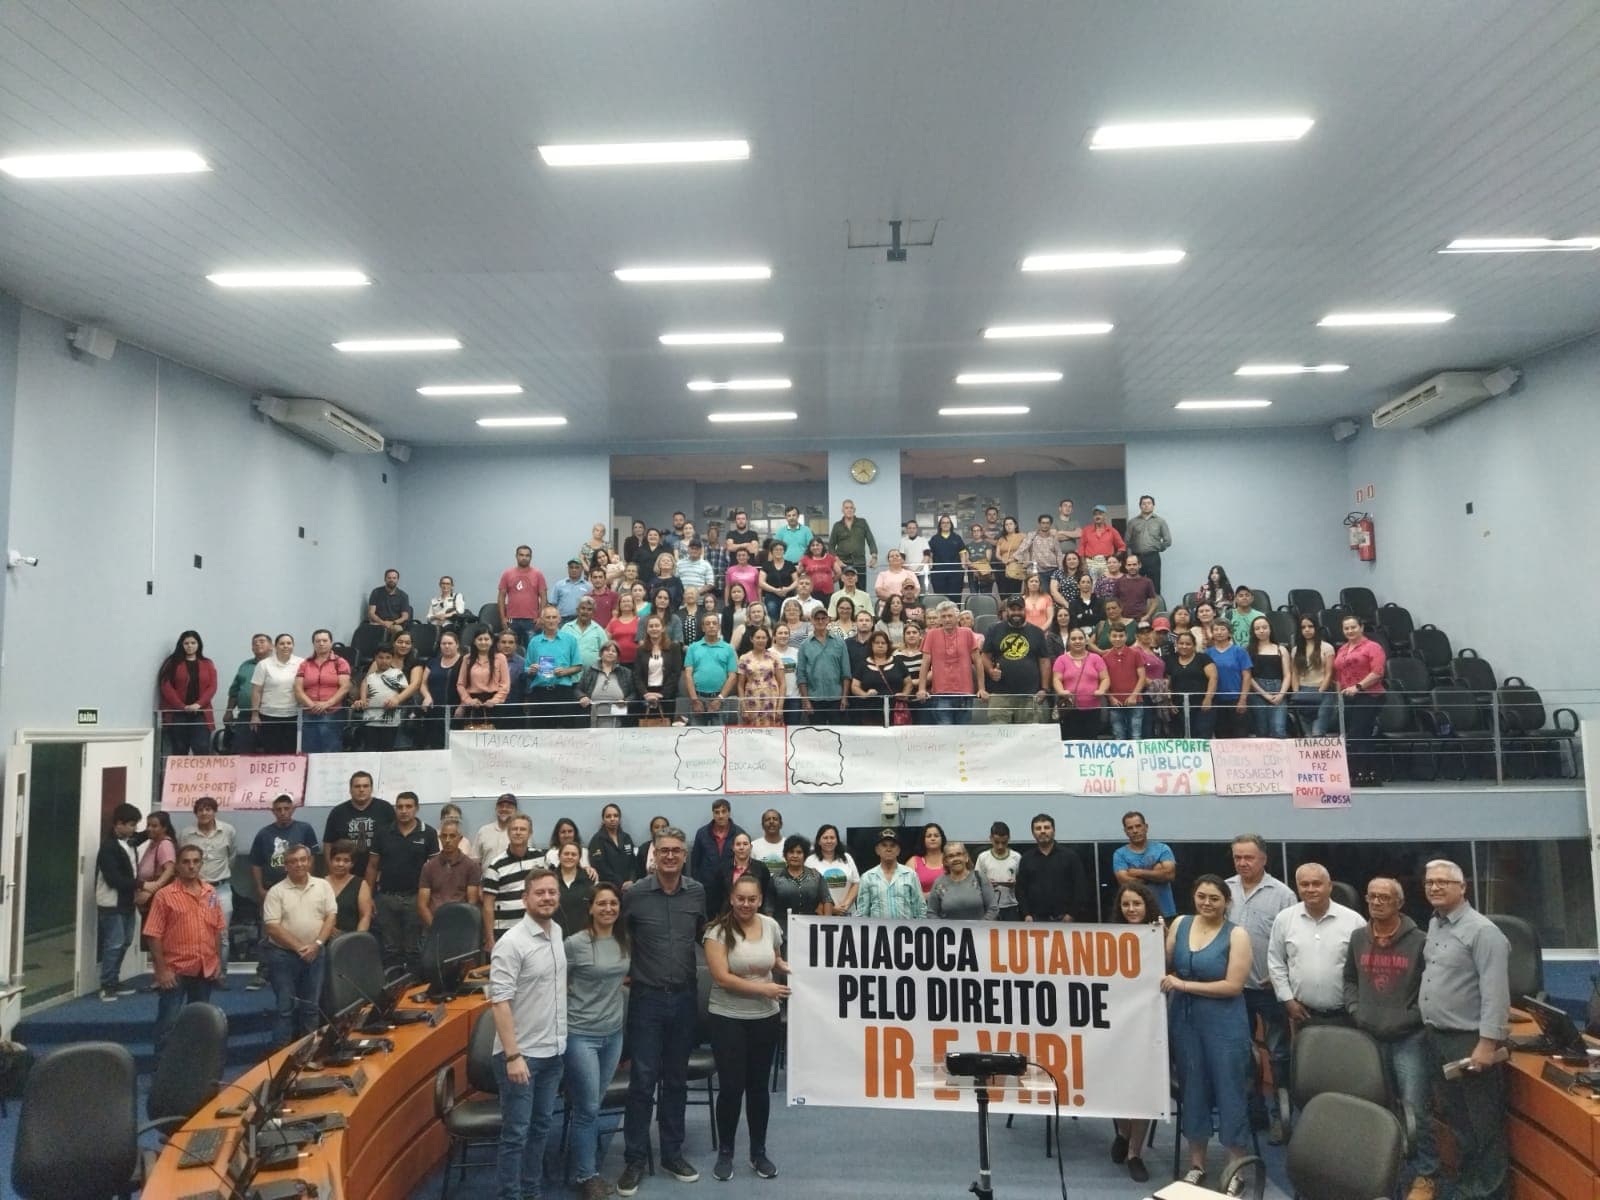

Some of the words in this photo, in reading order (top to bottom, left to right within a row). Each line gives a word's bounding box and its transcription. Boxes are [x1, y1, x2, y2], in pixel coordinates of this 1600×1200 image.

[79, 711, 96, 721] SAÍDA
[474, 732, 538, 748] ITAIACOCA
[1295, 737, 1342, 747] ITAIACOCA
[1064, 742, 1134, 759] ITAIACOCA
[1137, 740, 1210, 754] TRANSPORTE
[1298, 748, 1341, 759] TAMBÉM
[170, 757, 236, 770] PRECISAMOS
[249, 761, 296, 775] DIREITO
[1080, 760, 1114, 777] ESTÁ
[1141, 754, 1202, 771] PÚBLICO
[1311, 762, 1327, 771] FAZ
[196, 772, 209, 781] DE
[1226, 767, 1284, 779] PASSAGEM
[1297, 773, 1325, 783] PARTE
[1330, 773, 1342, 783] DE
[170, 782, 237, 793] TRANSPORTE
[264, 777, 281, 788] DE
[259, 791, 267, 803] E
[1295, 786, 1325, 797] PONTA
[1321, 794, 1351, 804] GROSSA
[808, 924, 979, 972] ITAIACOCA
[989, 928, 1141, 978] LUTANDO
[838, 974, 917, 1021] PELO
[927, 978, 1057, 1027] DIREITO
[1068, 981, 1111, 1029] DE
[865, 1025, 915, 1099] IR
